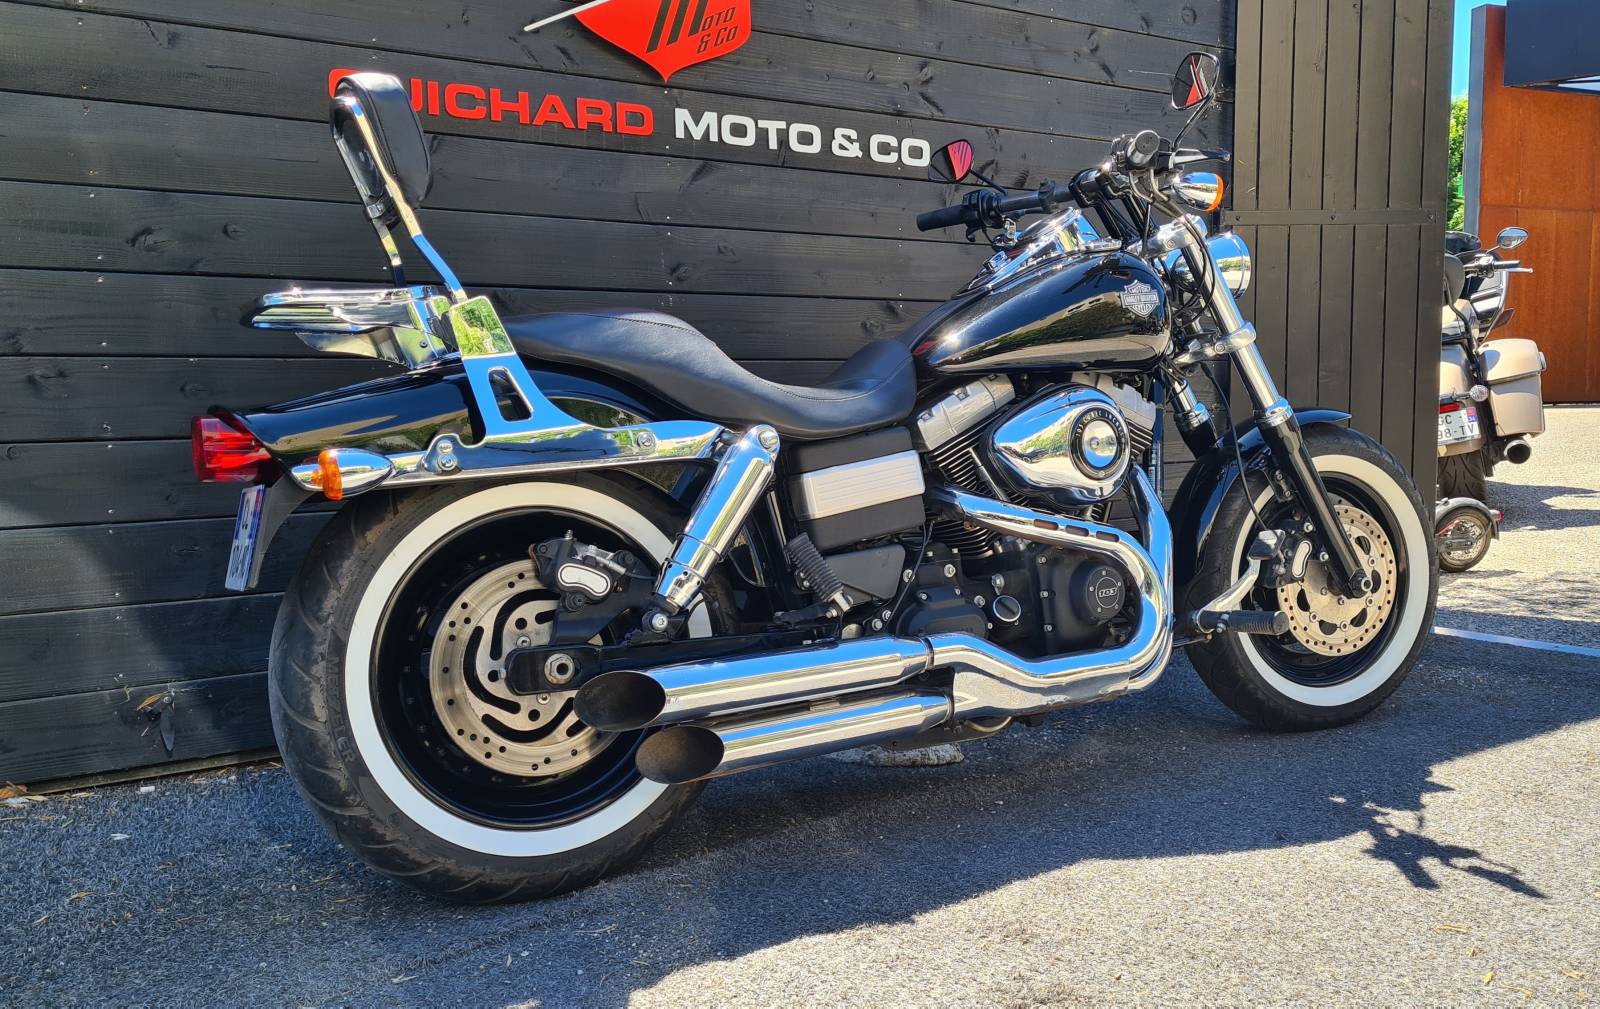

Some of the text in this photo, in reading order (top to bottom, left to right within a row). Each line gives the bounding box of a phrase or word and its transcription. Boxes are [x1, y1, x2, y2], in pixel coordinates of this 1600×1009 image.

[674, 107, 822, 154] MOTO
[831, 127, 863, 158] &
[869, 133, 931, 167] CO
[1099, 587, 1117, 597] 103
